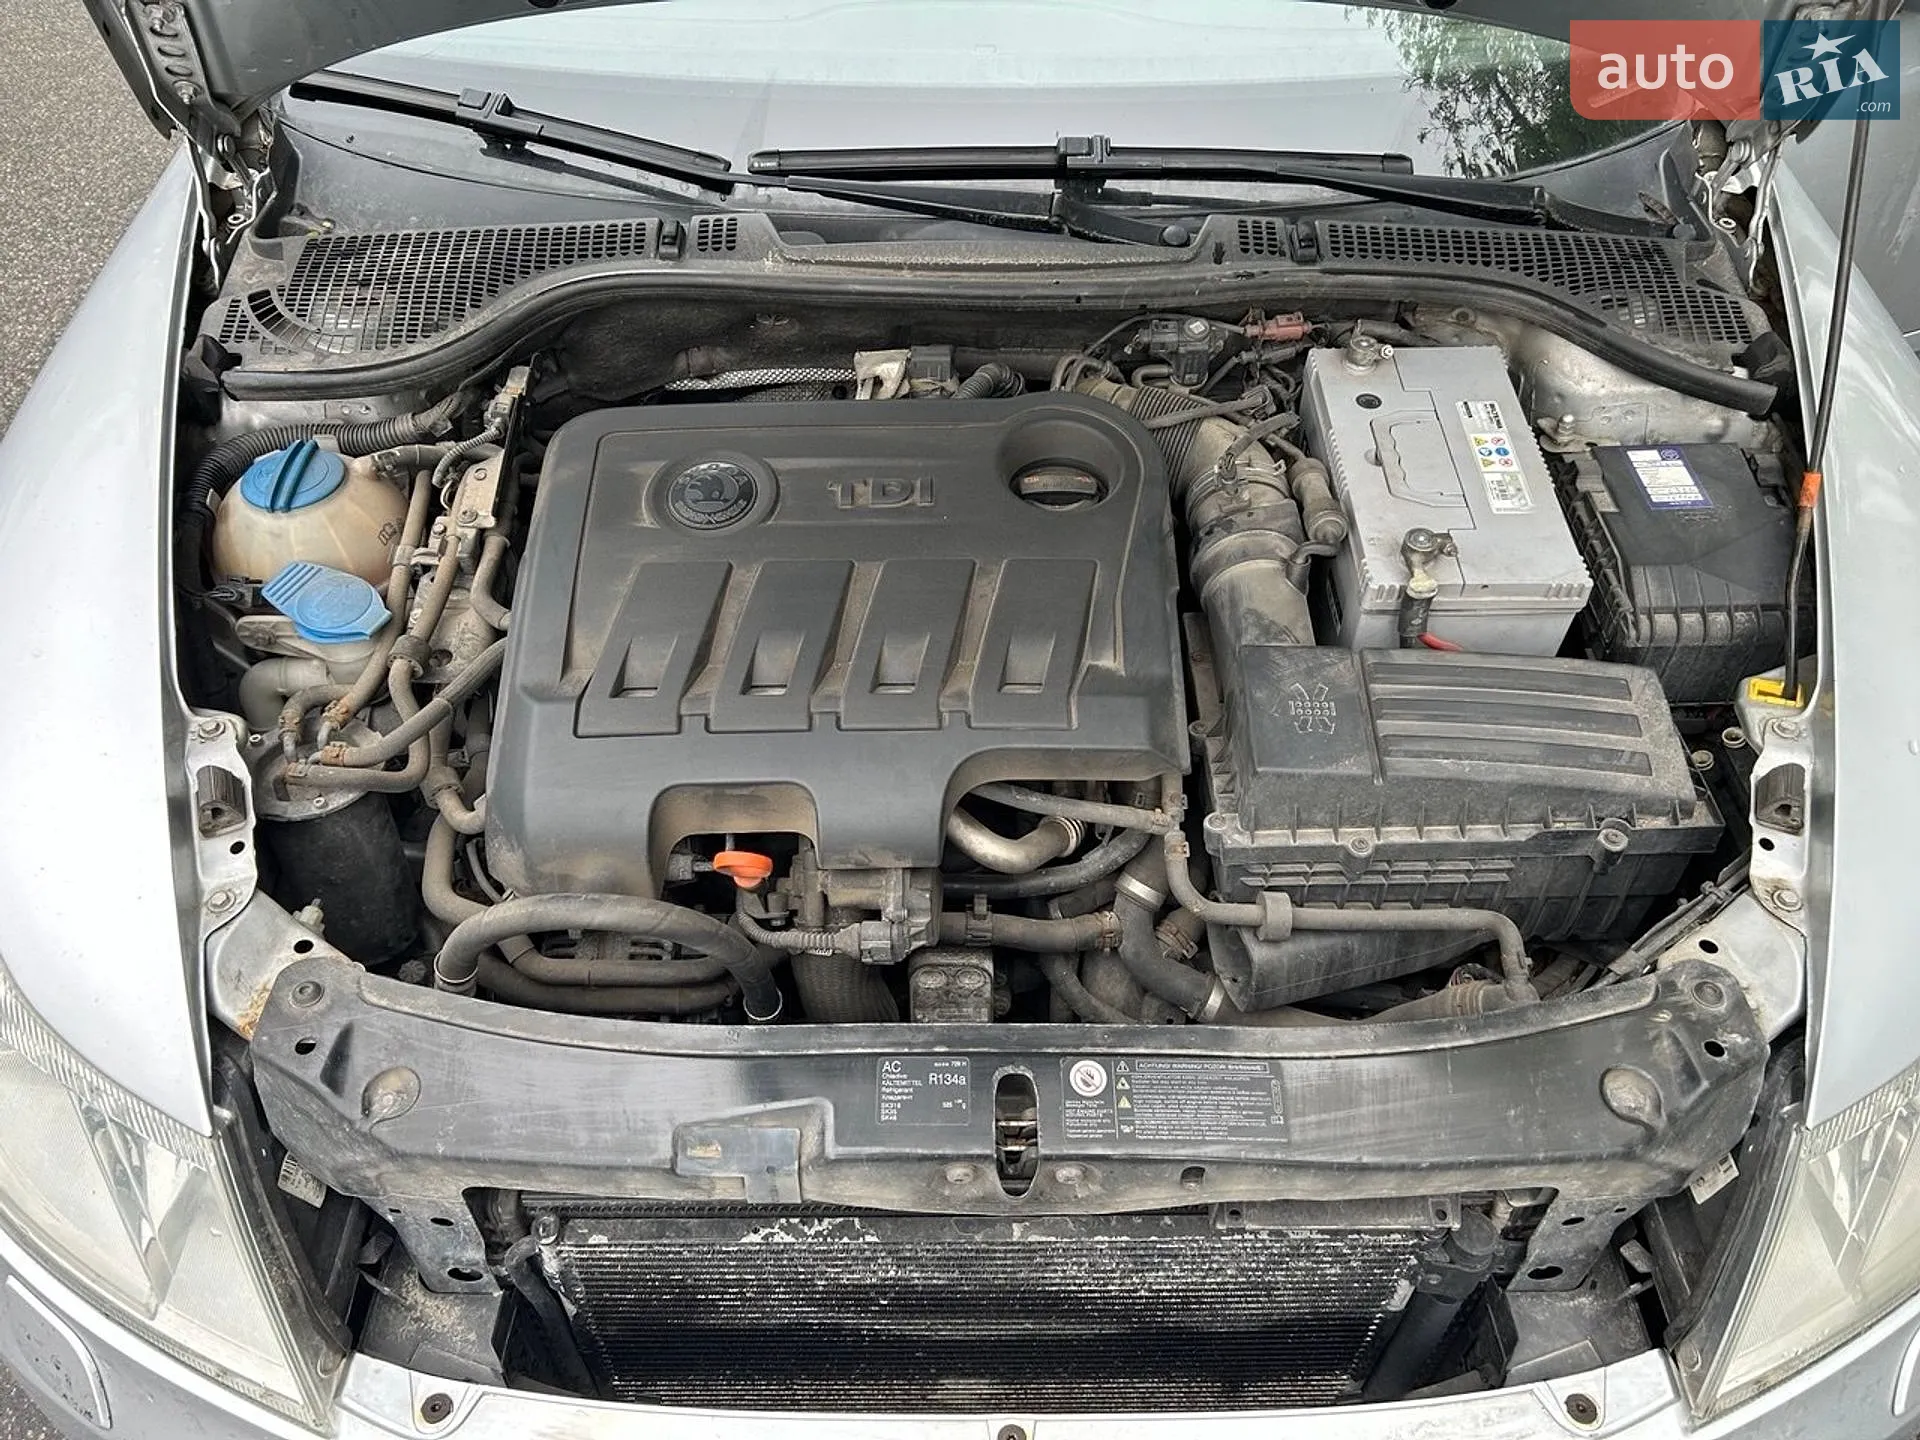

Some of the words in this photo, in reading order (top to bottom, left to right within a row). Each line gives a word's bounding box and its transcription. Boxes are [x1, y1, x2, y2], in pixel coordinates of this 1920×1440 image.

[828, 477, 935, 509] TDI
[881, 1060, 902, 1073] AC
[928, 1073, 967, 1086] R134a
